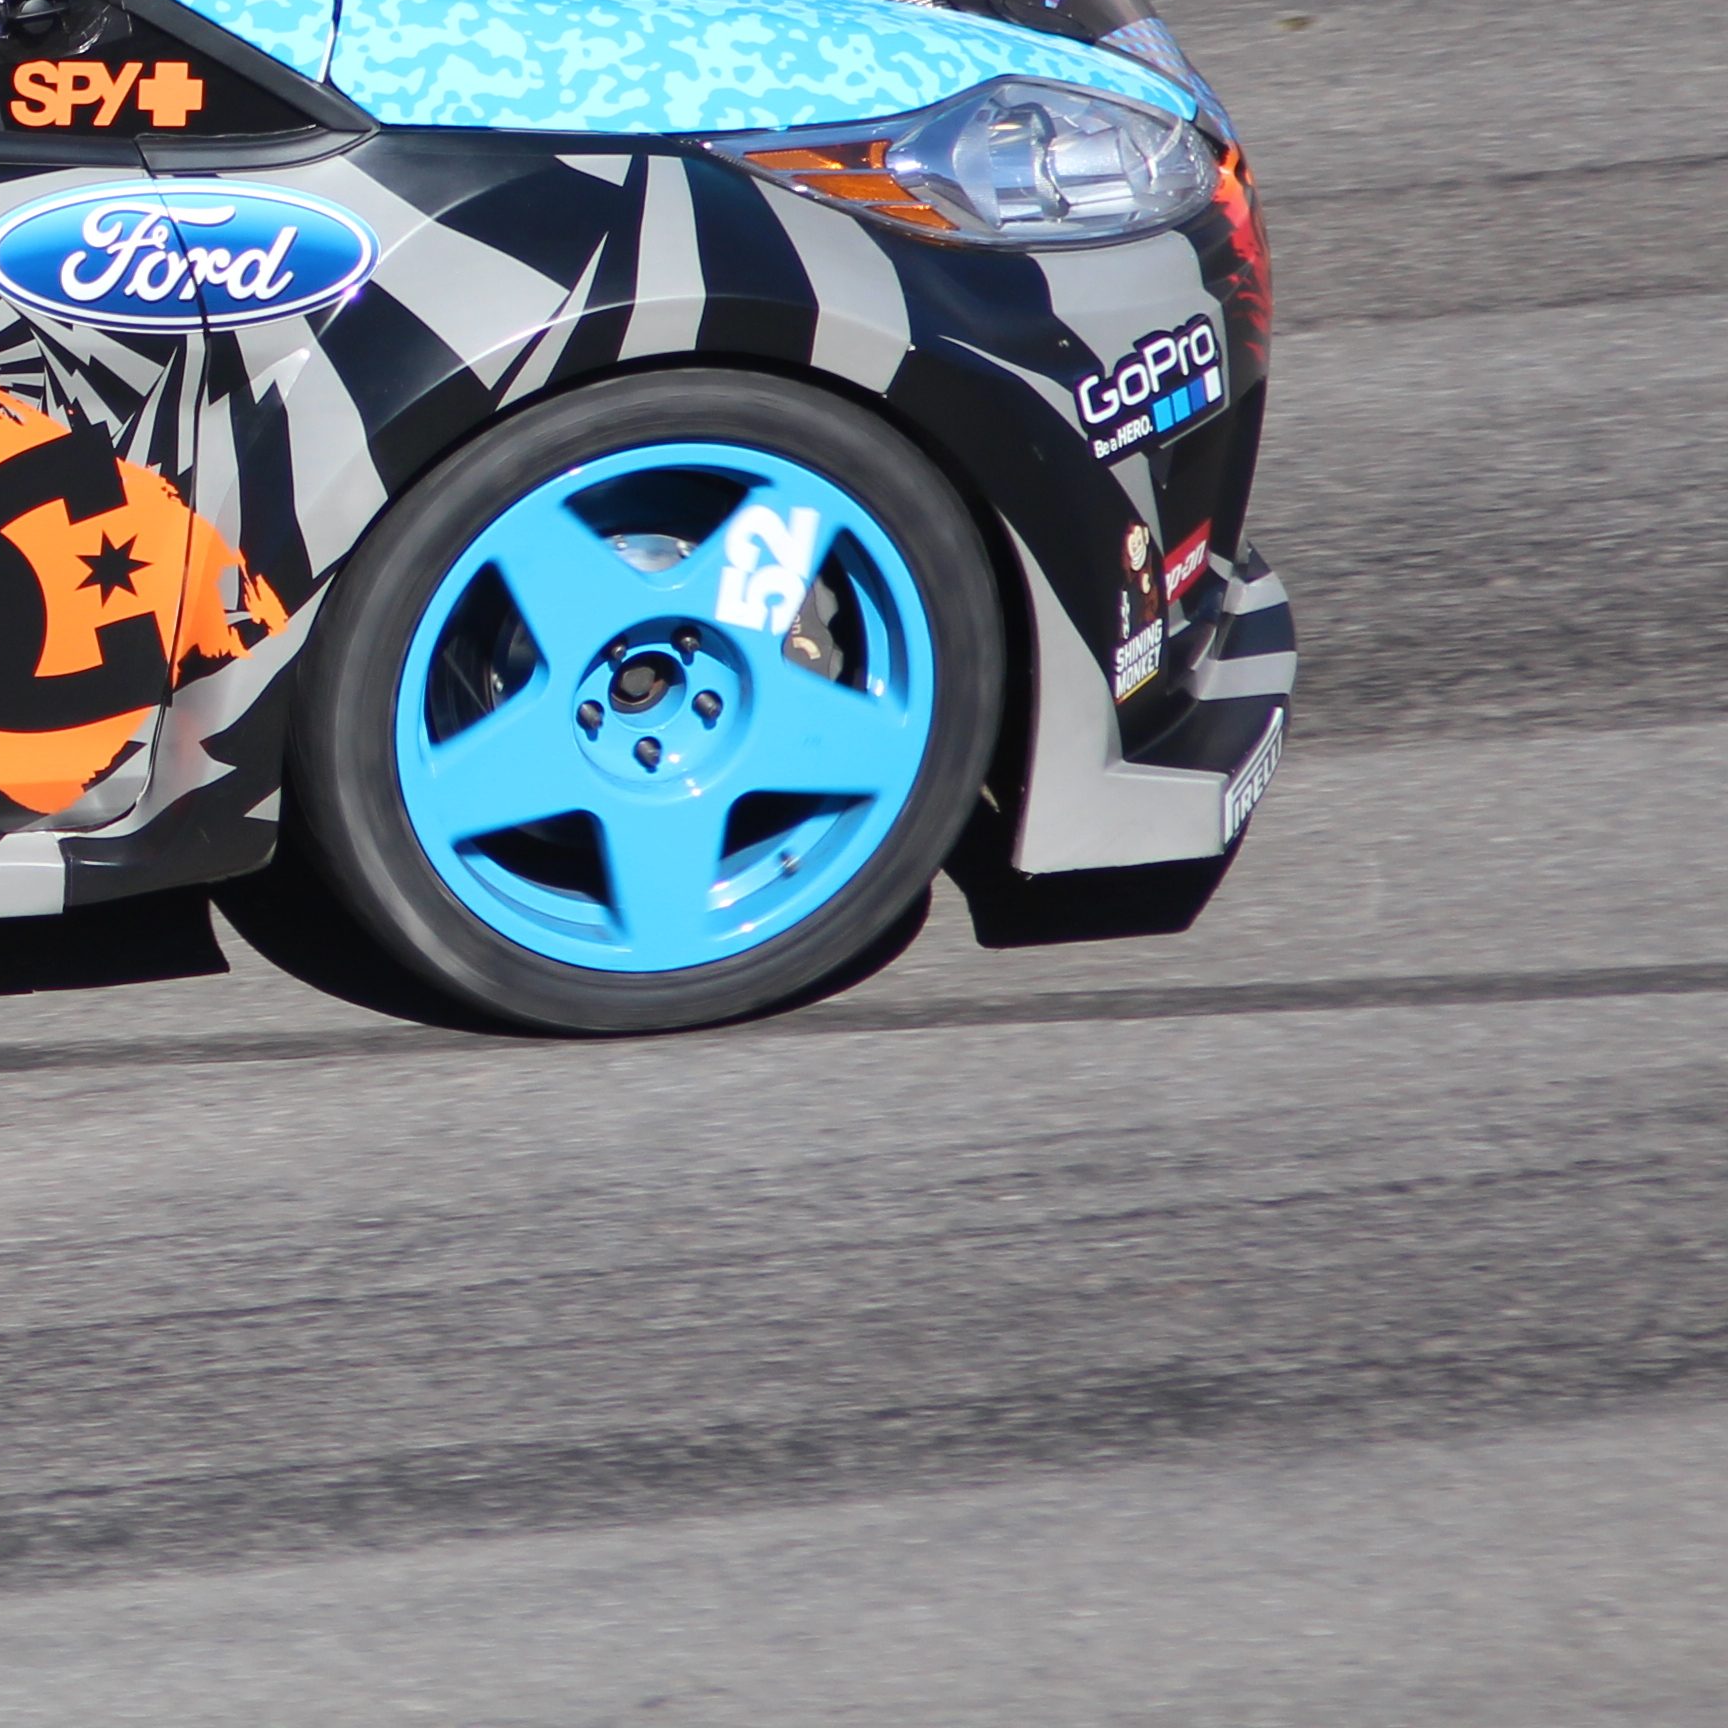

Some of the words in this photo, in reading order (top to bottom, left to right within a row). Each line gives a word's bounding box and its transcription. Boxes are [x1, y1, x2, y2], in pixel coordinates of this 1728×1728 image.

[59, 203, 299, 304] Ford
[1078, 323, 1216, 424] GoPro
[1093, 439, 1111, 459] Be
[1117, 414, 1154, 449] HERO.
[714, 504, 821, 635] 52
[1115, 618, 1163, 673] SHINING
[1115, 643, 1162, 699] MONKEY
[1224, 706, 1284, 845] PIRELLI
